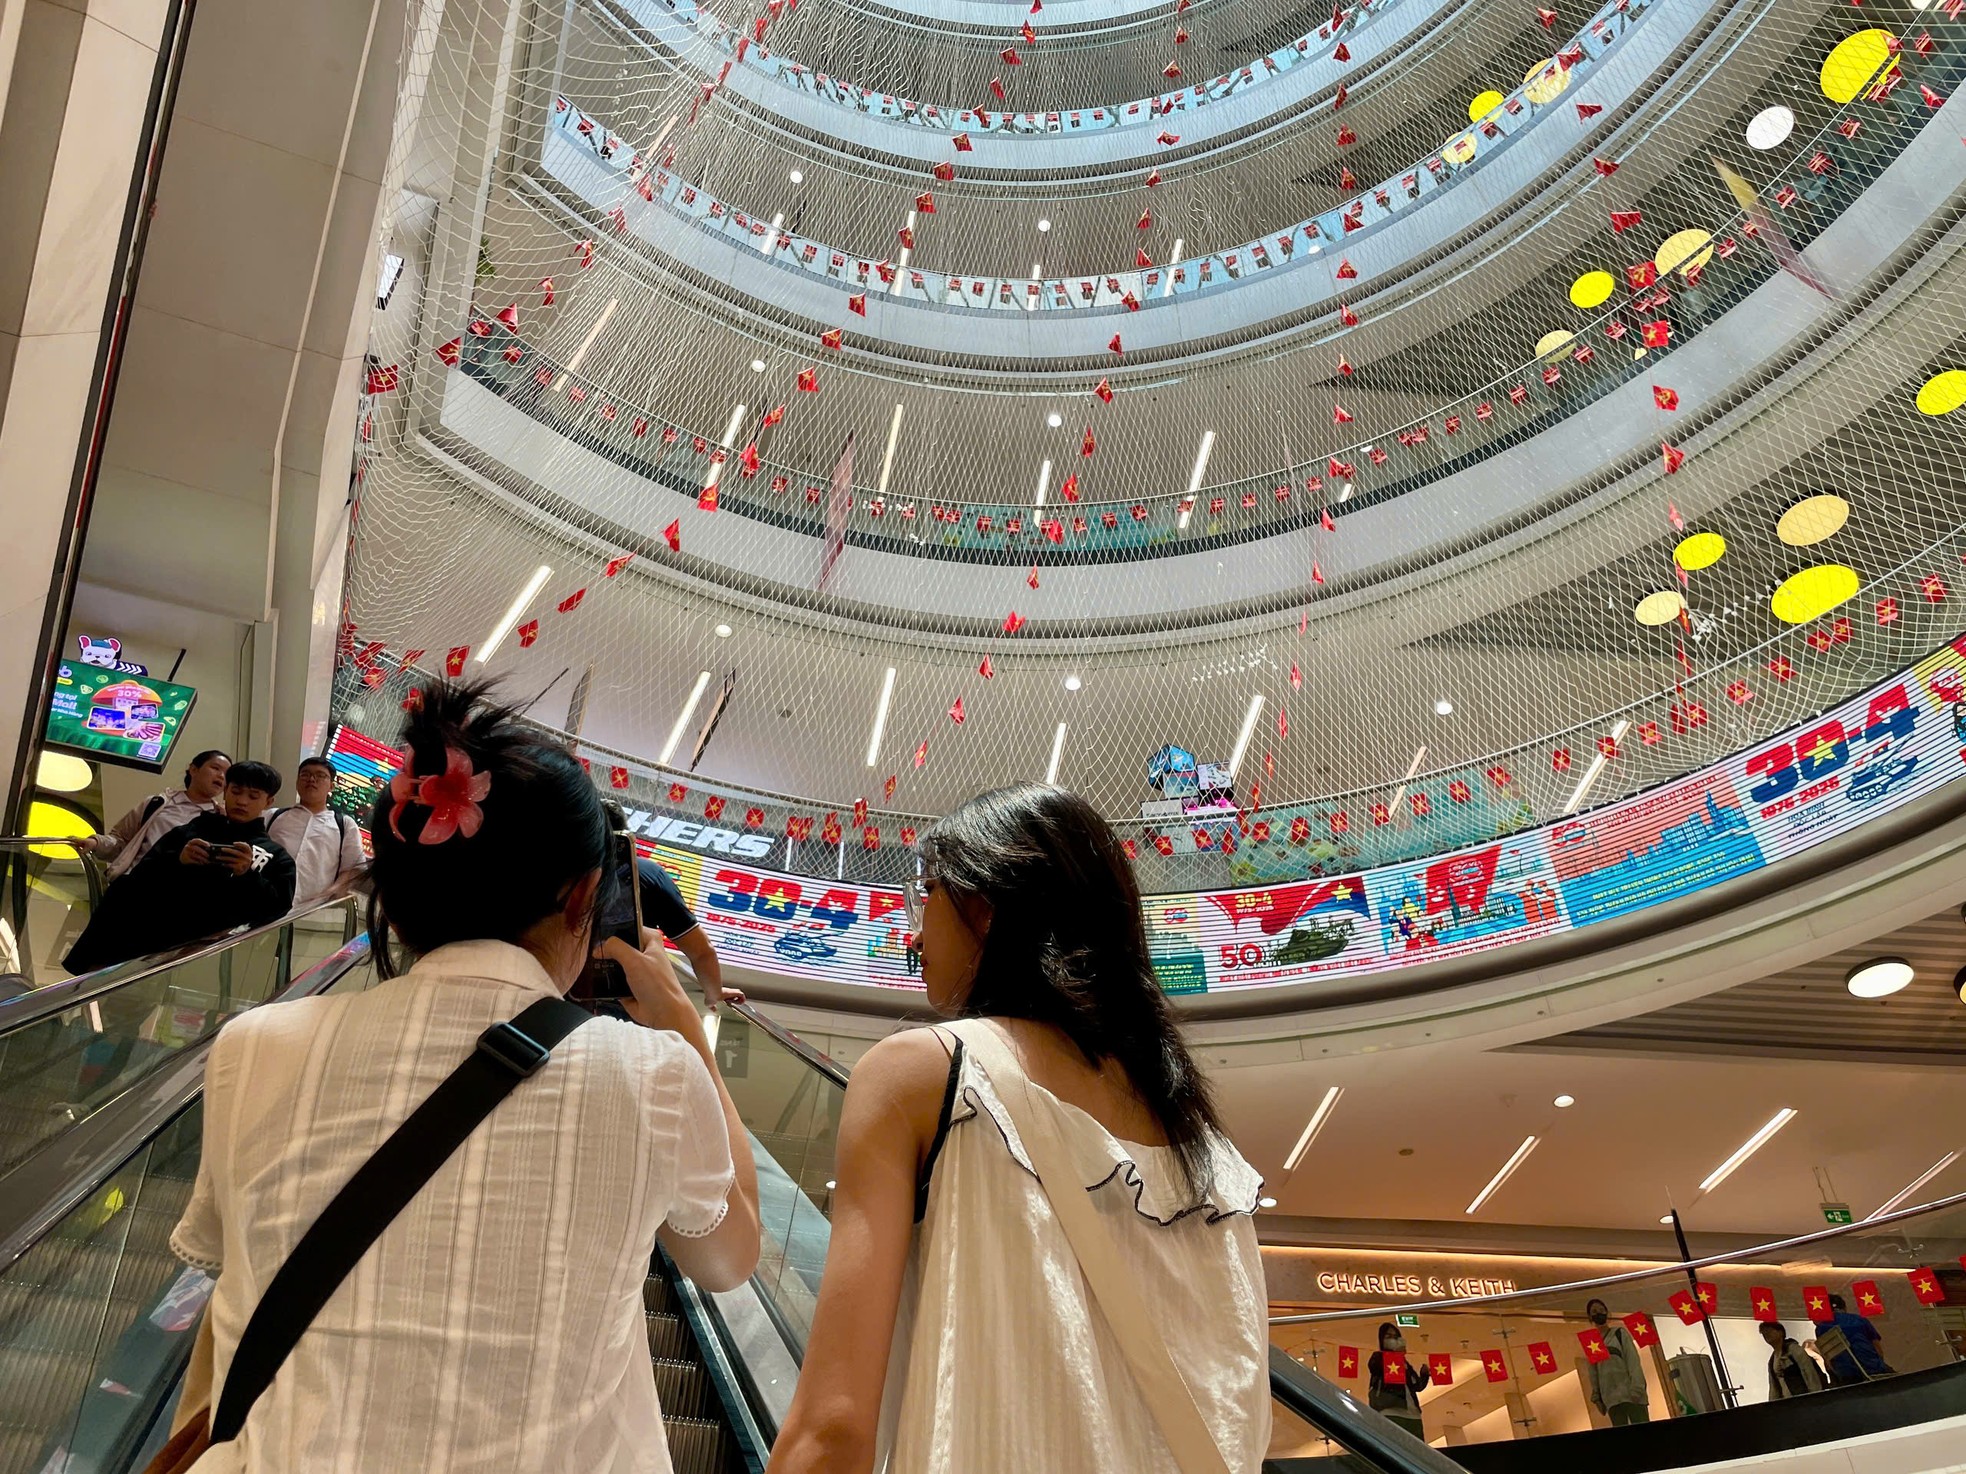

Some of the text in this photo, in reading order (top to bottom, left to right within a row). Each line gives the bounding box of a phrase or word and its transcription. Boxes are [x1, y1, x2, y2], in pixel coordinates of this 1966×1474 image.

[621, 806, 775, 858] HERS
[708, 869, 859, 931] 30-4
[1235, 892, 1273, 908] 30-4
[1220, 942, 1263, 969] 50
[1317, 1271, 1517, 1298] CHARLES & KEITH
